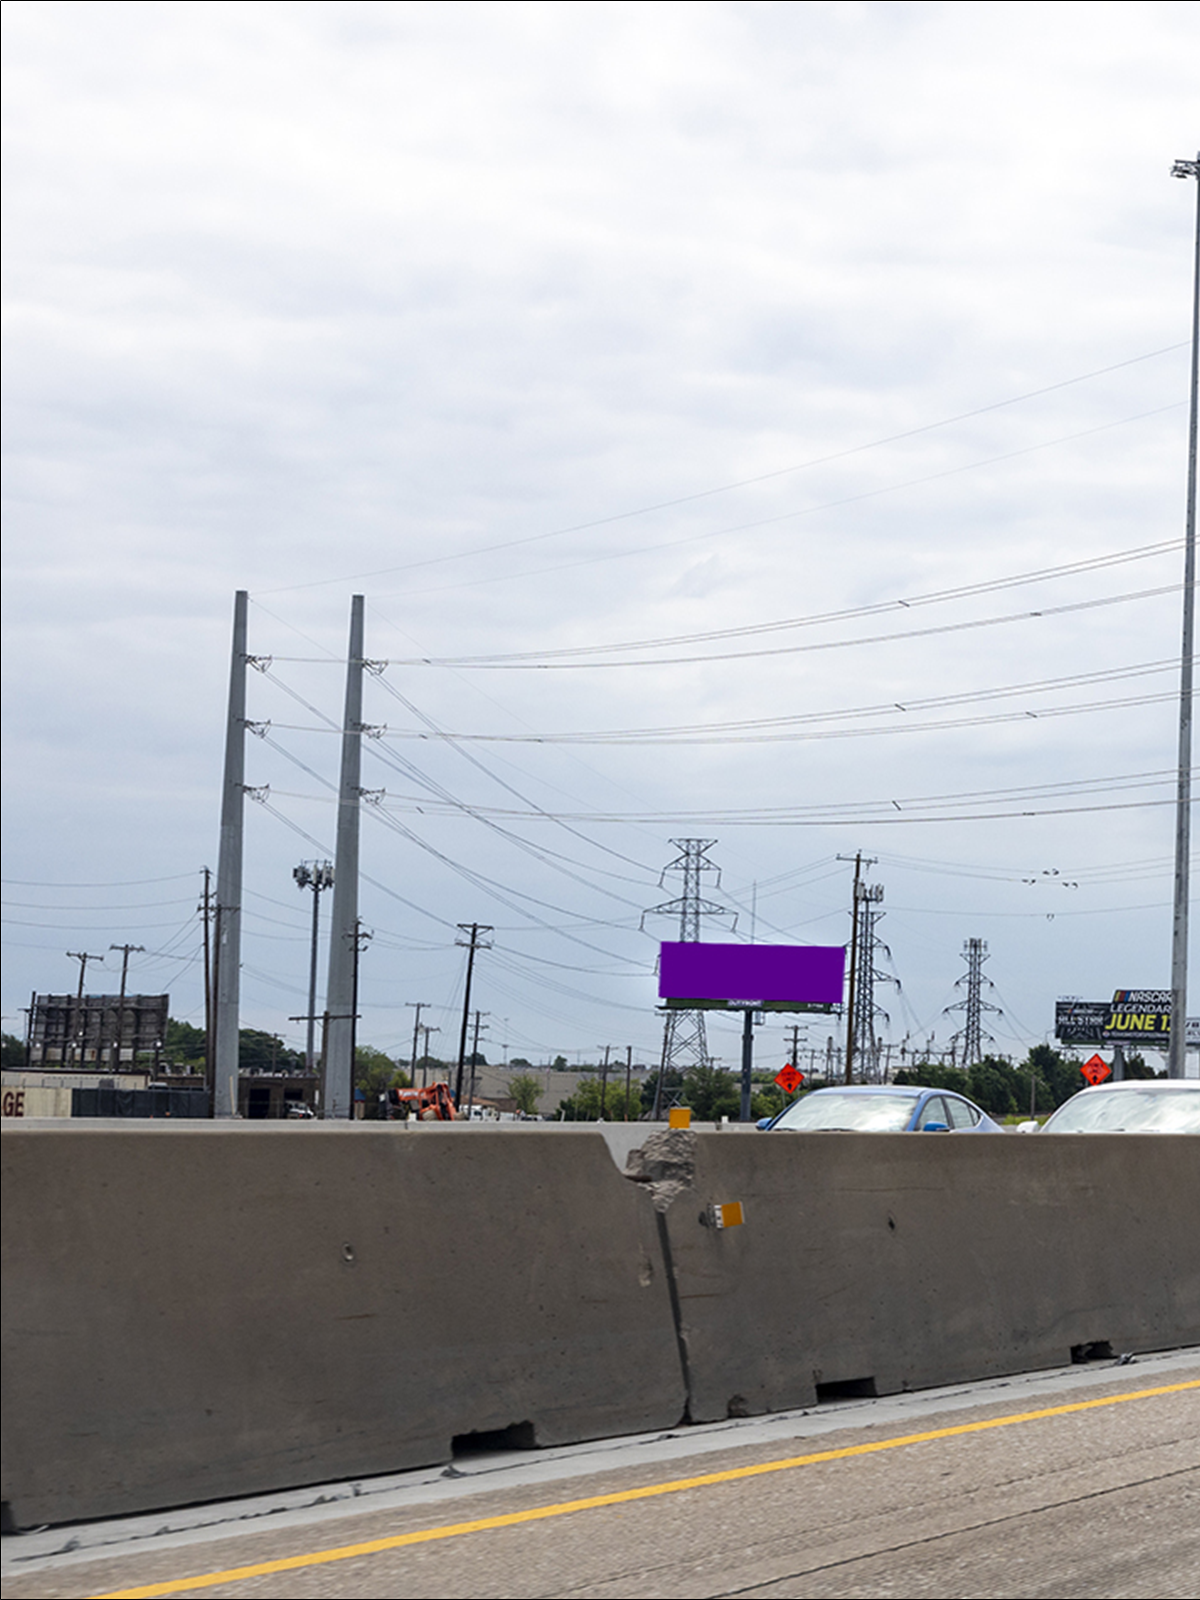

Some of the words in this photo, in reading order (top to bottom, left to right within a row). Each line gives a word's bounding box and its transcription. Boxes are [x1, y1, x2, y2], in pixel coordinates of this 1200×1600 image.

[1110, 1003, 1172, 1014] LEGENDAR
[1105, 1013, 1157, 1031] JUNE
[1161, 1014, 1172, 1031] 1
